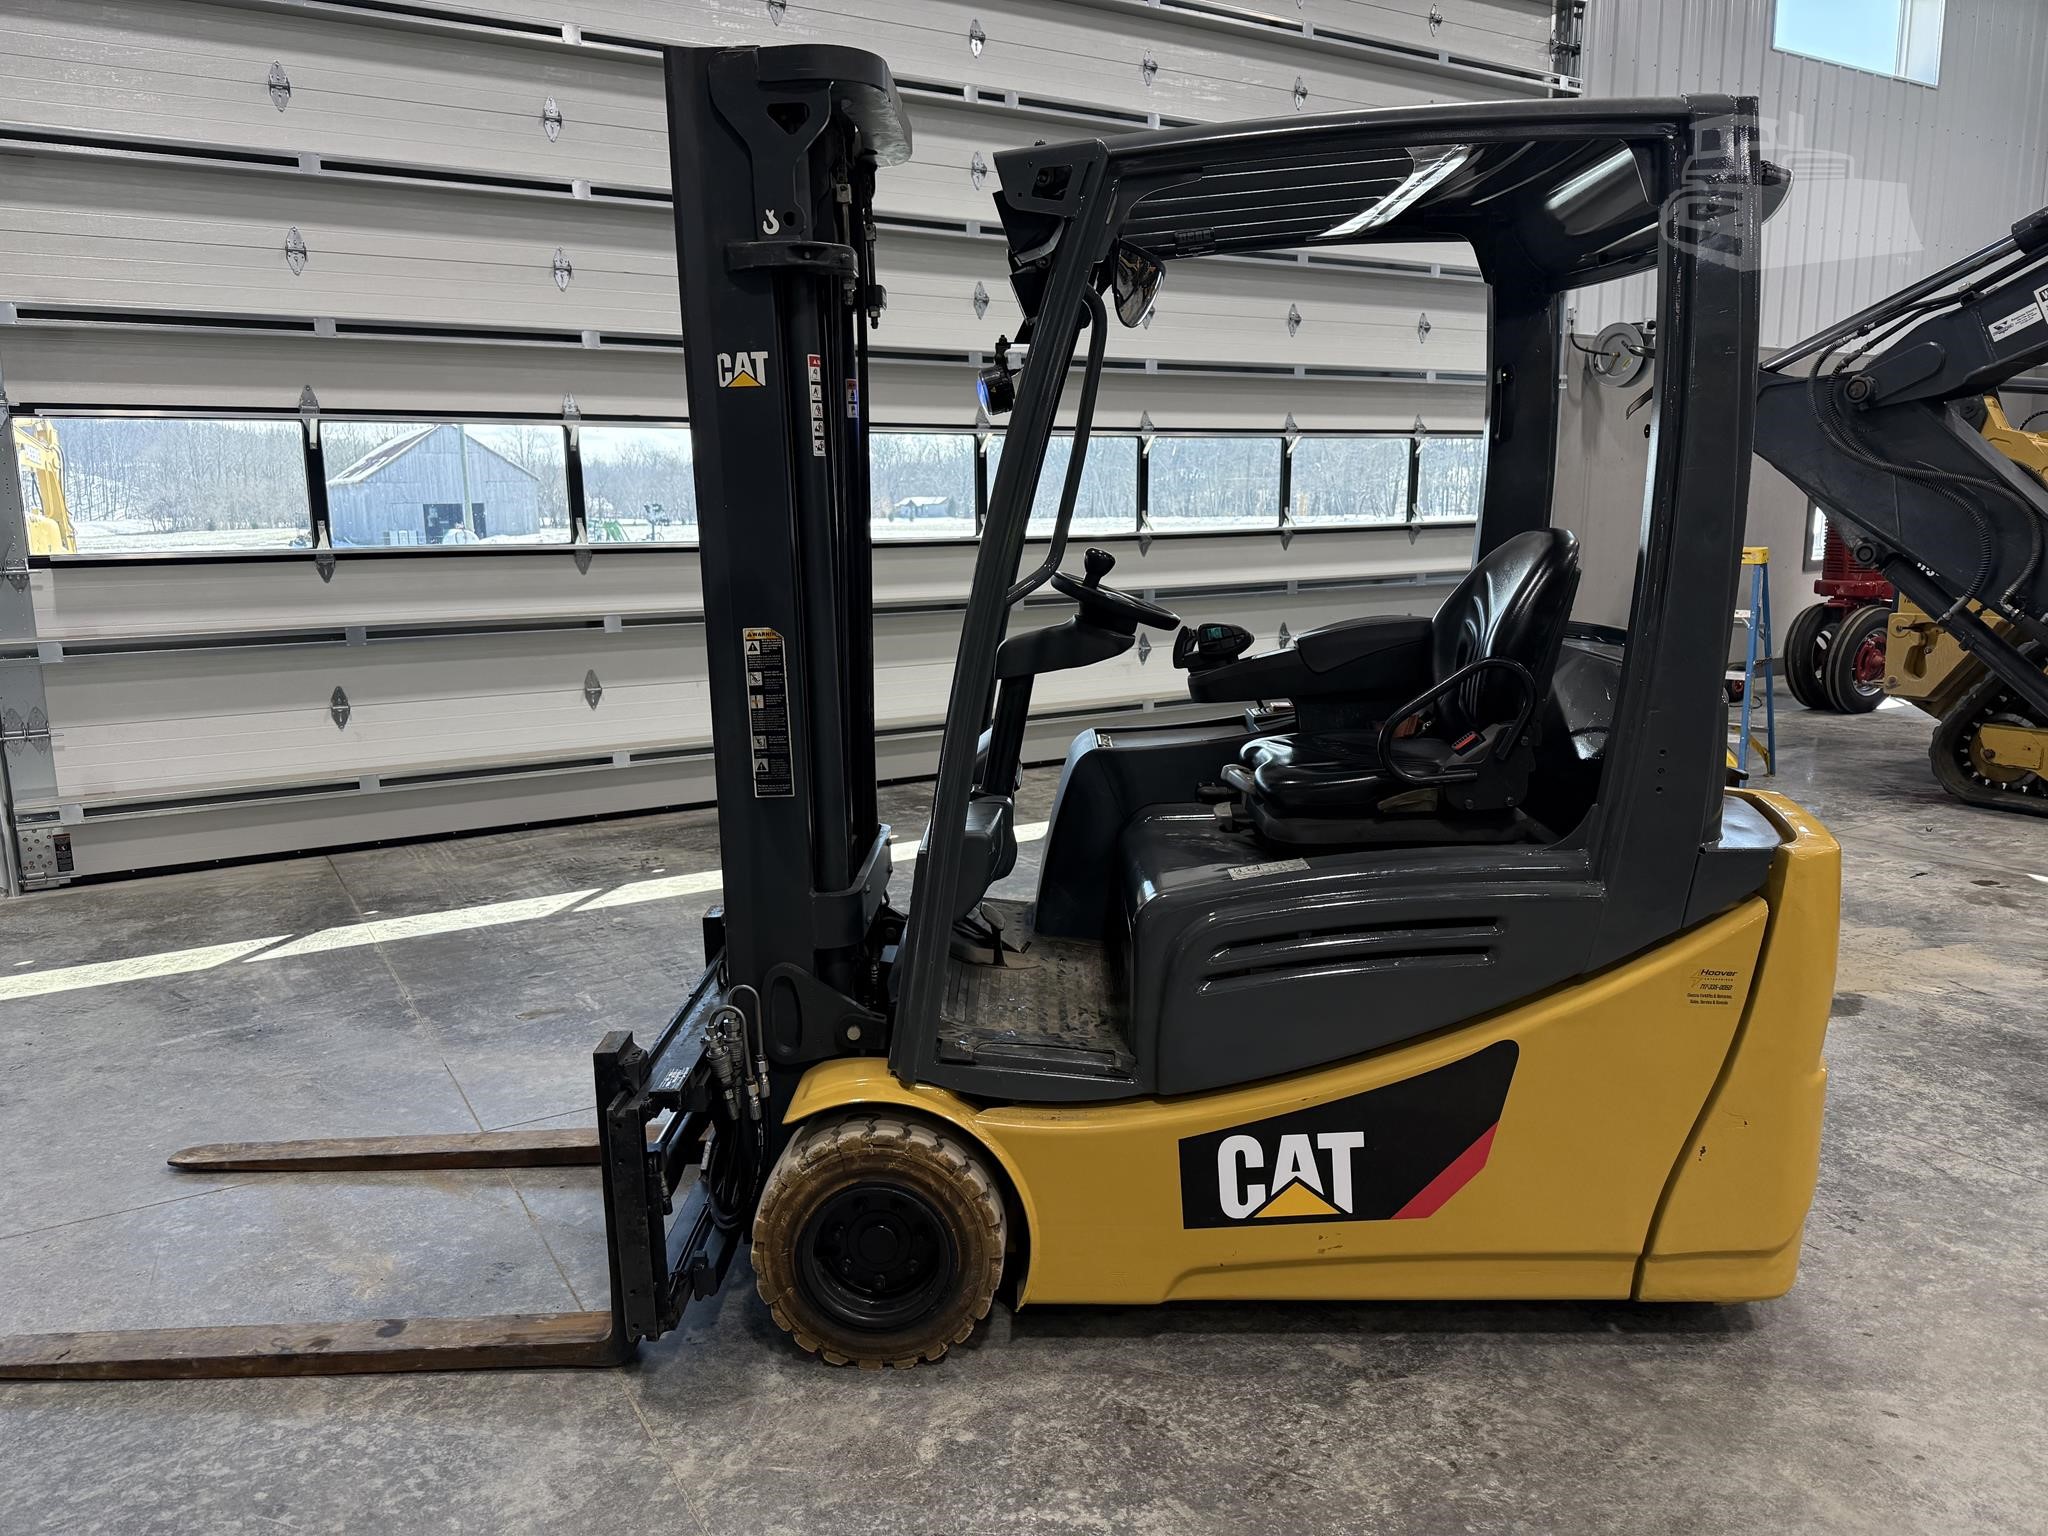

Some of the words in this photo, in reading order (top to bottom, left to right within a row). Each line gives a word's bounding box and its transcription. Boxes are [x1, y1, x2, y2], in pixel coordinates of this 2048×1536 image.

[716, 351, 769, 388] CAT
[1700, 968, 1738, 976] Hoover
[1217, 1131, 1365, 1220] CAT
